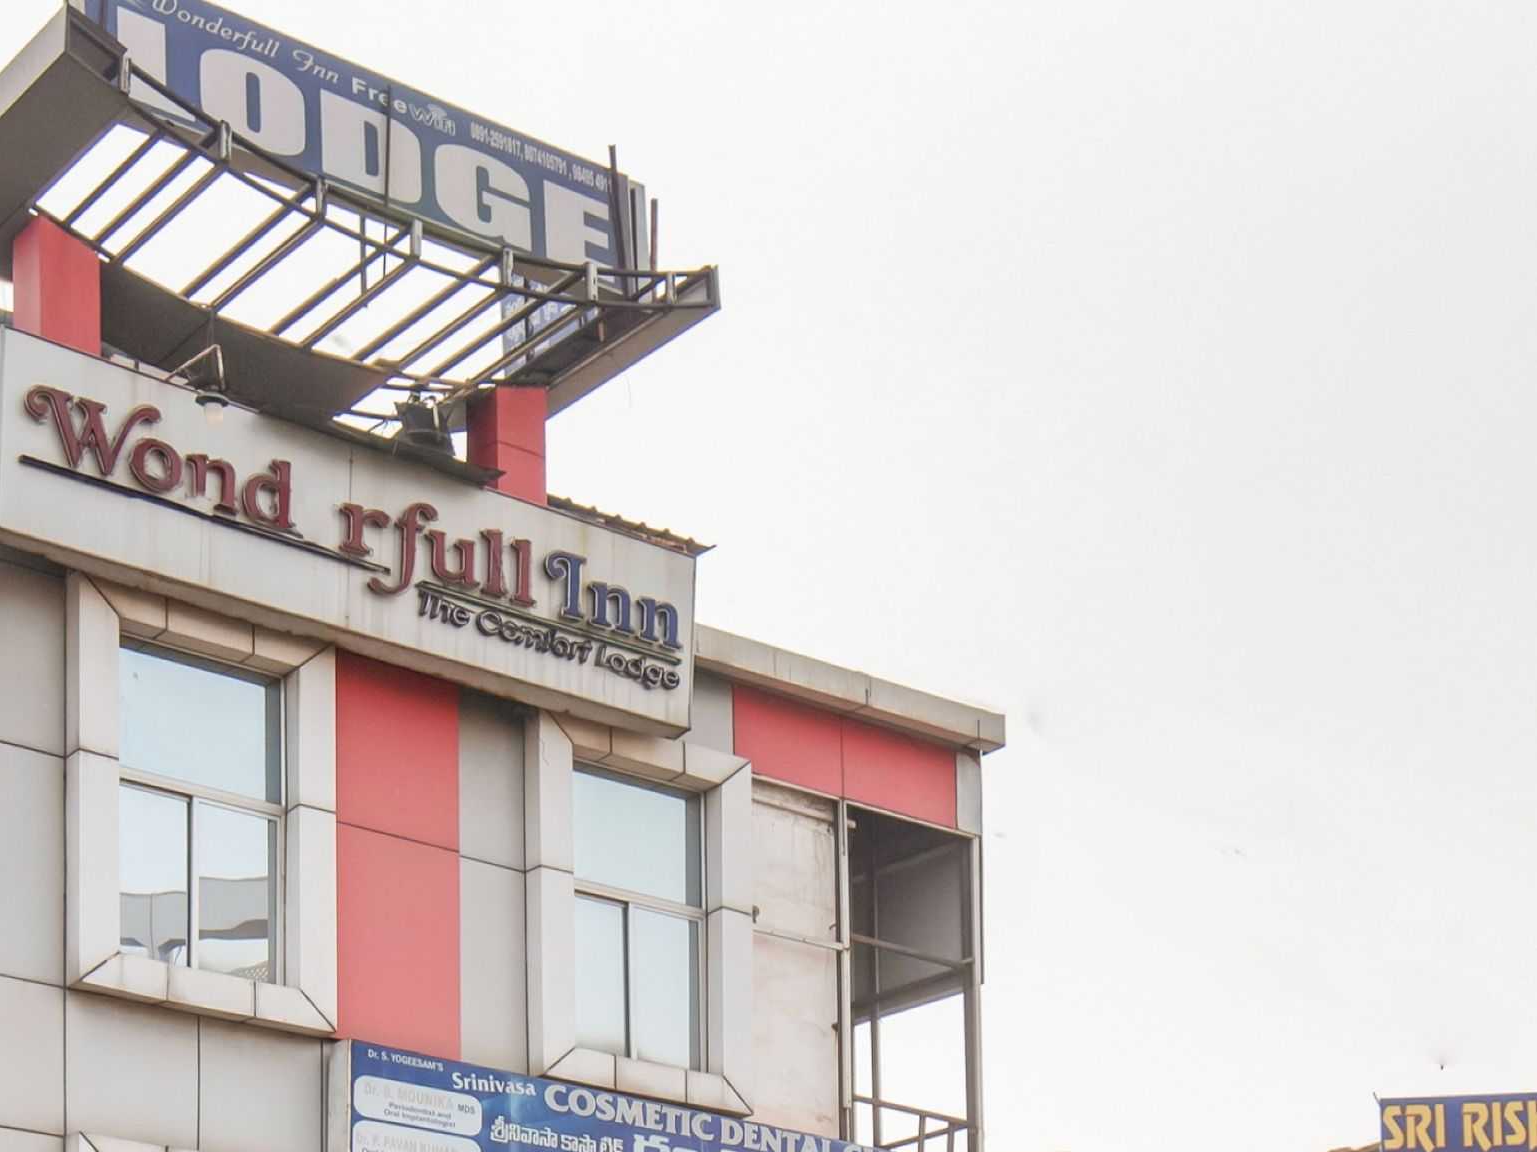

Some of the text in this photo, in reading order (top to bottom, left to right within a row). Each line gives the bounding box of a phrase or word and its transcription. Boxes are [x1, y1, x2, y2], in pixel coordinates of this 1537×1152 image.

[293, 49, 340, 85] Inn
[116, 5, 620, 293] LODGE
[542, 548, 683, 651] Inn
[416, 590, 680, 690] The Comfort Lodge
[368, 1048, 379, 1059] Dr.
[451, 1071, 537, 1097] Srinivasa
[544, 1084, 714, 1142] COSMETIC
[457, 1103, 477, 1115] MDS
